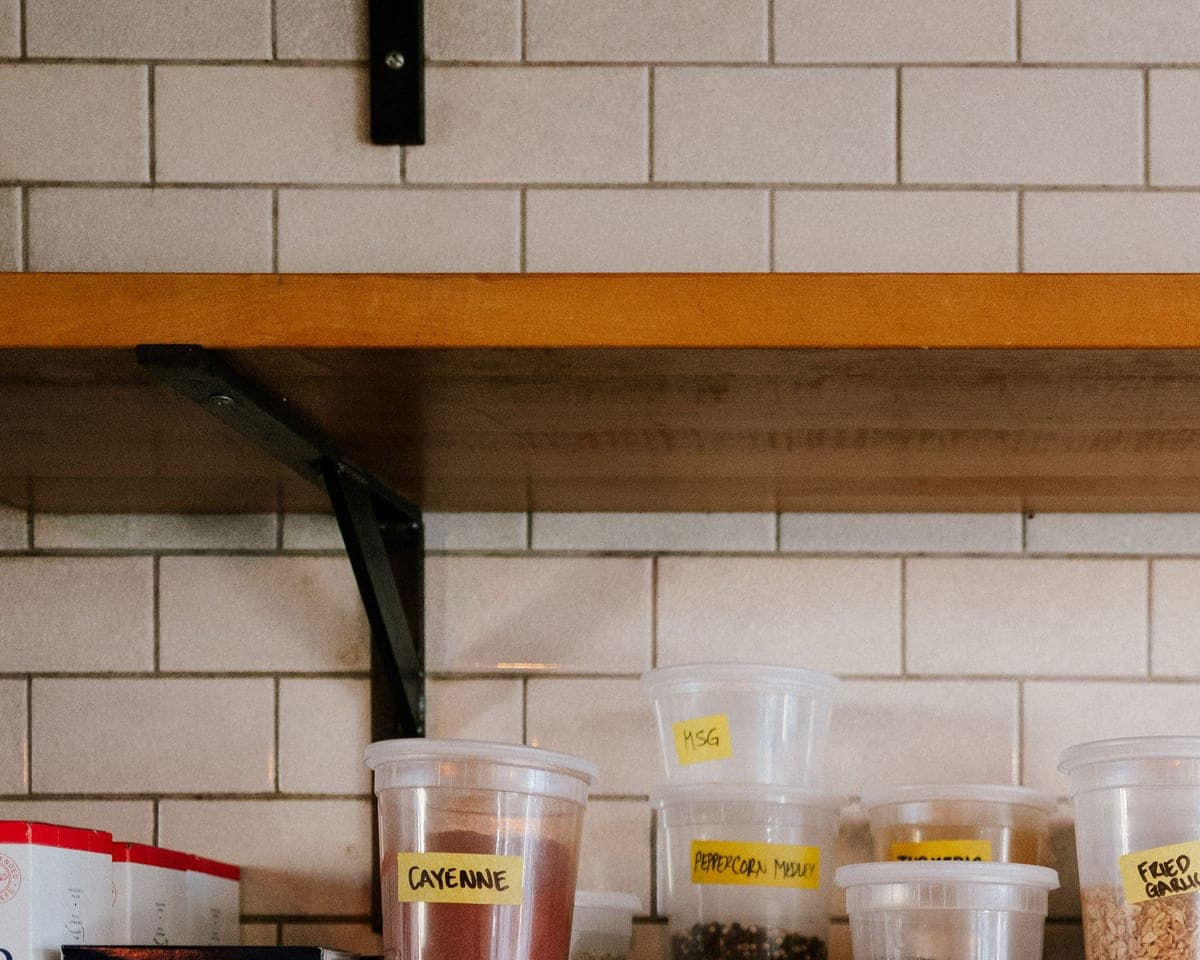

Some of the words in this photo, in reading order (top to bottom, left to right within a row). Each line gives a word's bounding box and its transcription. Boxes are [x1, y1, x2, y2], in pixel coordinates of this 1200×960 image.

[683, 728, 719, 750] MSG
[694, 850, 767, 877] PEPPERCORN
[1137, 854, 1191, 882] FRIED
[408, 866, 510, 891] CAYENNE
